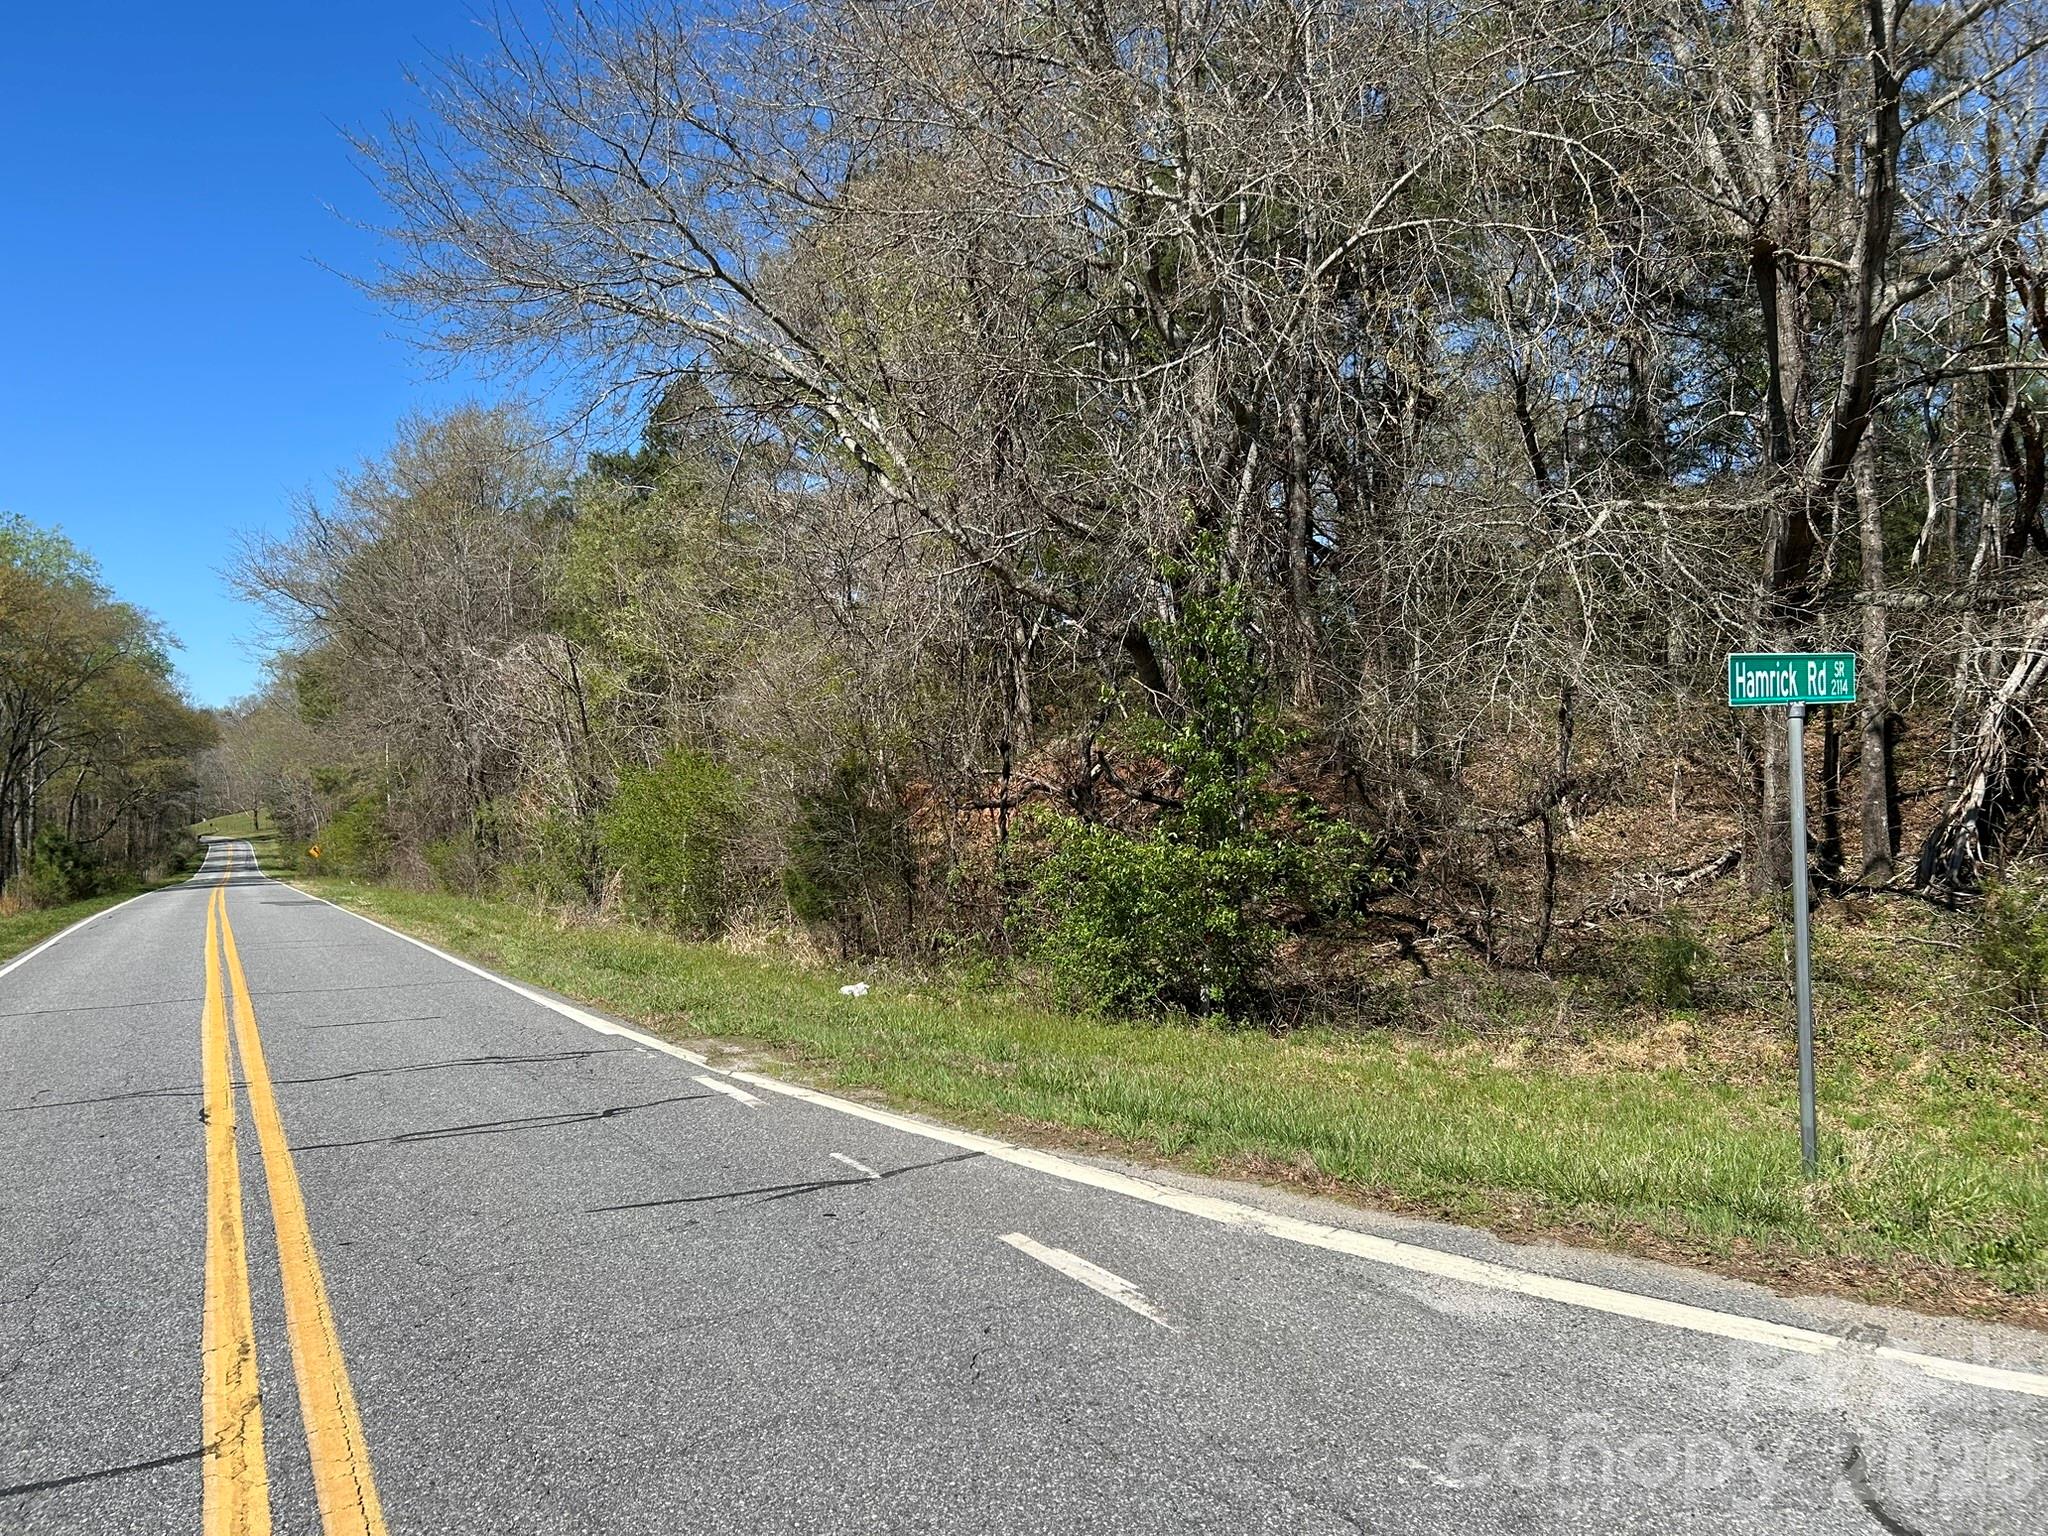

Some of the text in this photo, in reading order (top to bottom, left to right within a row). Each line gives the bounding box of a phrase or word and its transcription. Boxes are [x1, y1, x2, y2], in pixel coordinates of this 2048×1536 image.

[1834, 660, 1845, 678] SR
[1735, 660, 1827, 698] Hamrick Rd
[1830, 679, 1848, 696] 2114
